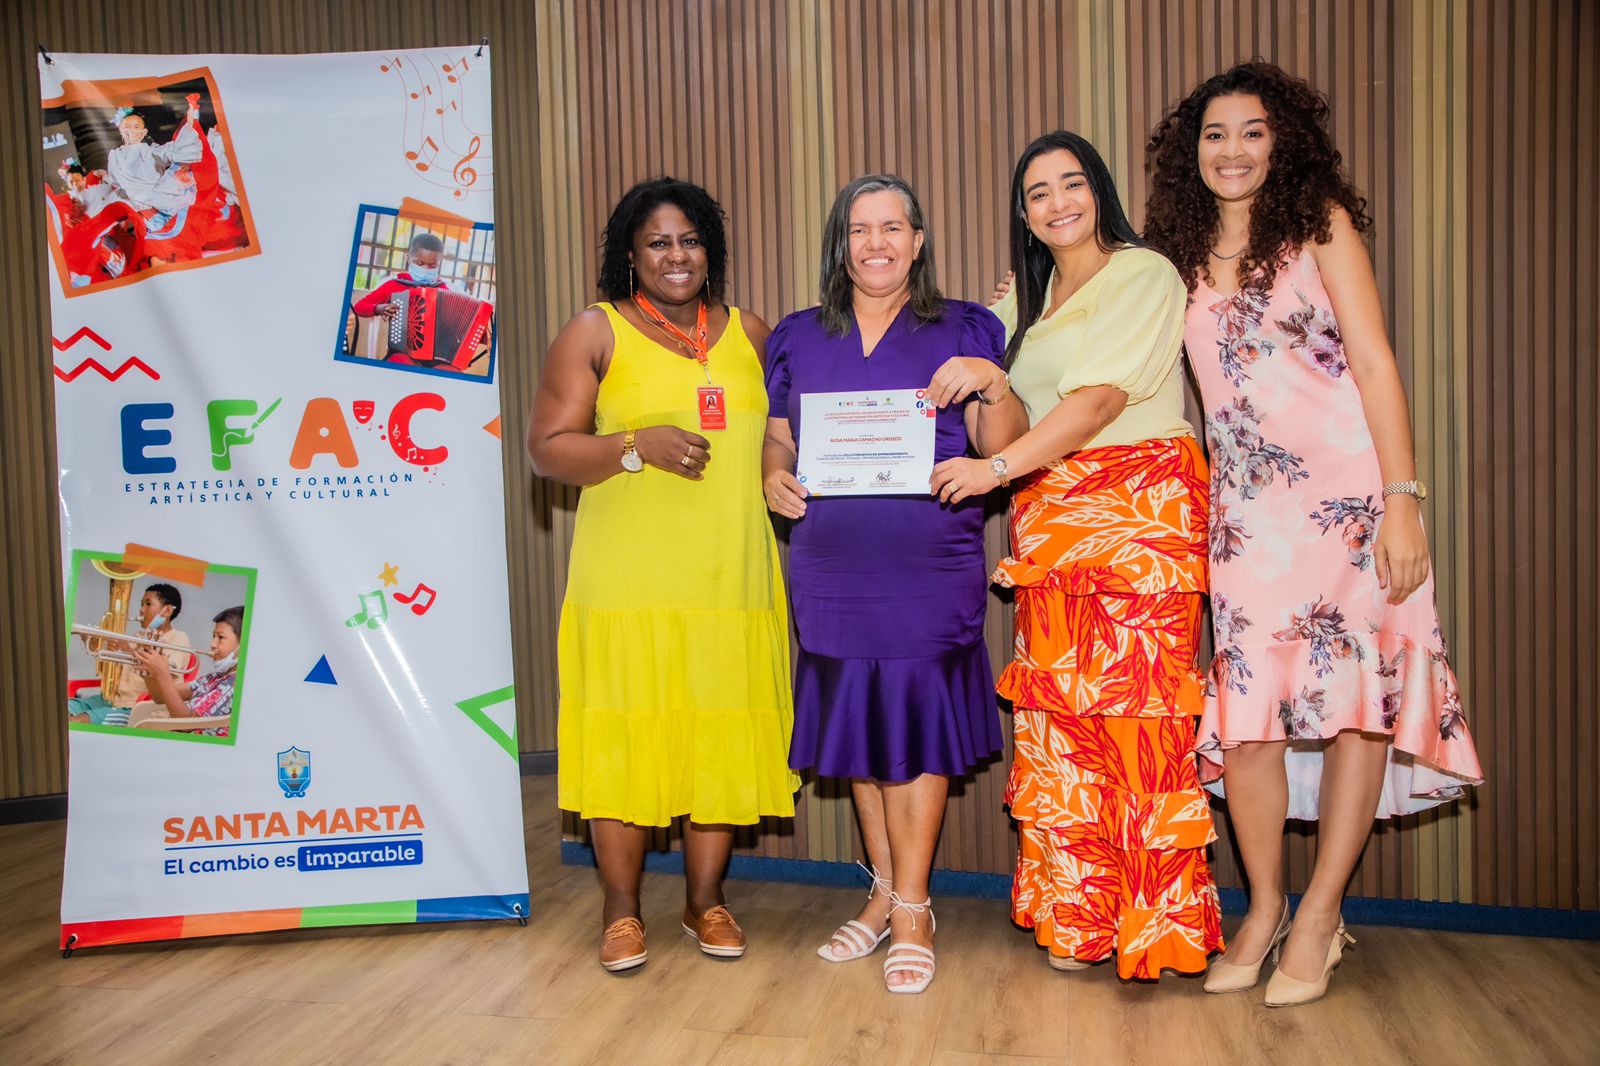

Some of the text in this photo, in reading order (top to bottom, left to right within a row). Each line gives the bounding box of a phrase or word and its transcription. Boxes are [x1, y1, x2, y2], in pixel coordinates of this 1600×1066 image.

[125, 472, 413, 492] ESTRATEGIA DE FORMACIÓN
[150, 488, 390, 505] ARTÍSTICA Y CULTURAL
[163, 804, 425, 844] SANTA MARTA
[164, 845, 416, 875] El cambio es imparable
